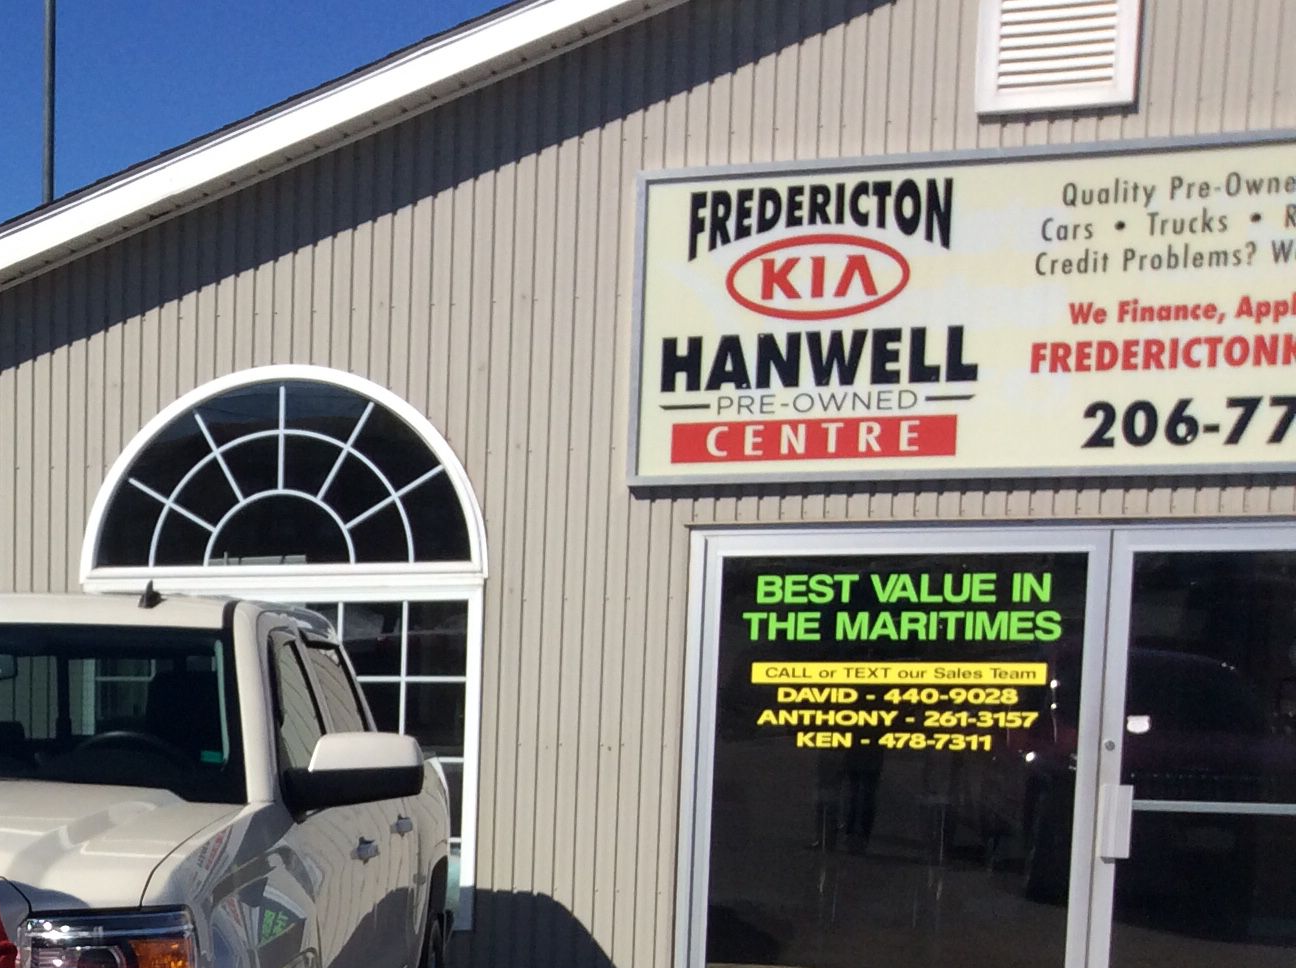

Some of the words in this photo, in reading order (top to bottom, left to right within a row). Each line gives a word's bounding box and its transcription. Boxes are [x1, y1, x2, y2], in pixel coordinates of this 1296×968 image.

[1062, 178, 1157, 208] Quality
[689, 178, 954, 262] FREDERICTON
[1041, 216, 1094, 243] Cars
[1147, 206, 1229, 237] Trucks
[1035, 250, 1109, 277] Credit
[1123, 240, 1257, 273] Problems?
[1271, 239, 1296, 264] W
[759, 254, 879, 301] KIA
[1070, 302, 1108, 325] We
[1116, 299, 1226, 325] Finance,
[660, 325, 979, 393] HANWELL
[716, 388, 918, 415] PRE-OWNED
[1081, 396, 1296, 448] 206-77
[706, 420, 920, 458] CENTRE
[756, 574, 859, 604] BEST
[871, 573, 997, 603] VALUE
[1012, 572, 1052, 602] IN
[742, 612, 821, 641] THE
[835, 611, 1062, 641] MARITIMES
[765, 667, 811, 679] CALL
[819, 669, 838, 679] or
[842, 667, 892, 679] TEXT
[897, 669, 927, 679] our
[934, 667, 983, 680] Sales
[990, 667, 1037, 680] Team
[777, 688, 858, 703] DAVID
[883, 688, 1019, 705] 440-9028
[756, 709, 899, 726] ANTHONY
[923, 711, 1039, 728] 261-3157
[796, 732, 852, 748] KEN
[878, 732, 992, 751] 478-7311
